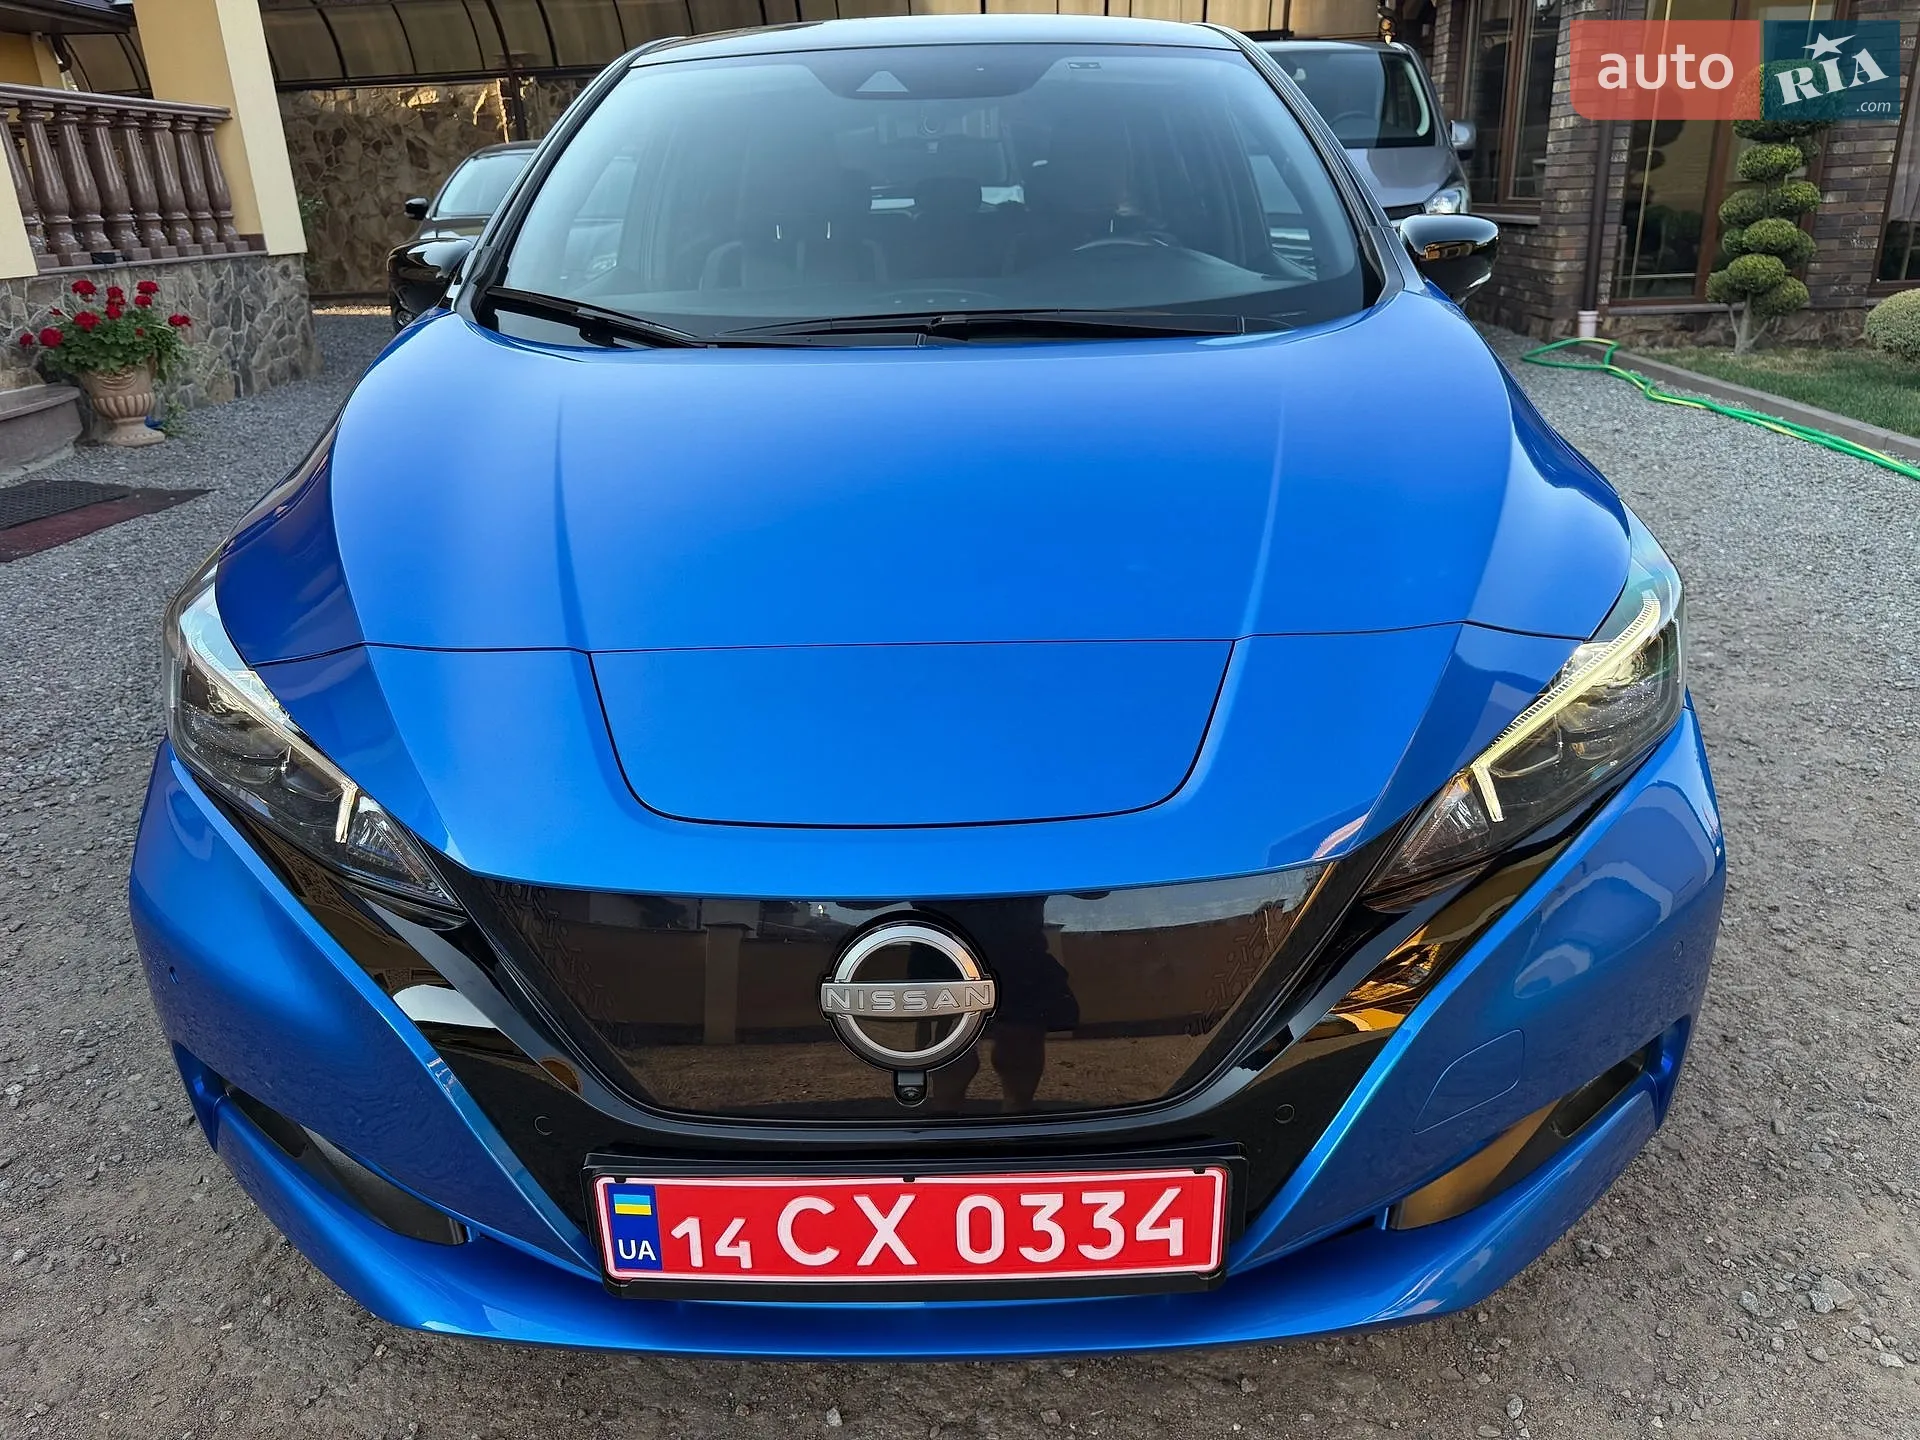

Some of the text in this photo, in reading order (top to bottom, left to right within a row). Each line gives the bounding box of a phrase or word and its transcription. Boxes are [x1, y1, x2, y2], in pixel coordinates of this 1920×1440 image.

[825, 984, 992, 1012] NISSAN
[670, 1187, 1185, 1269] 14 CX 0334
[618, 1238, 657, 1262] UA
